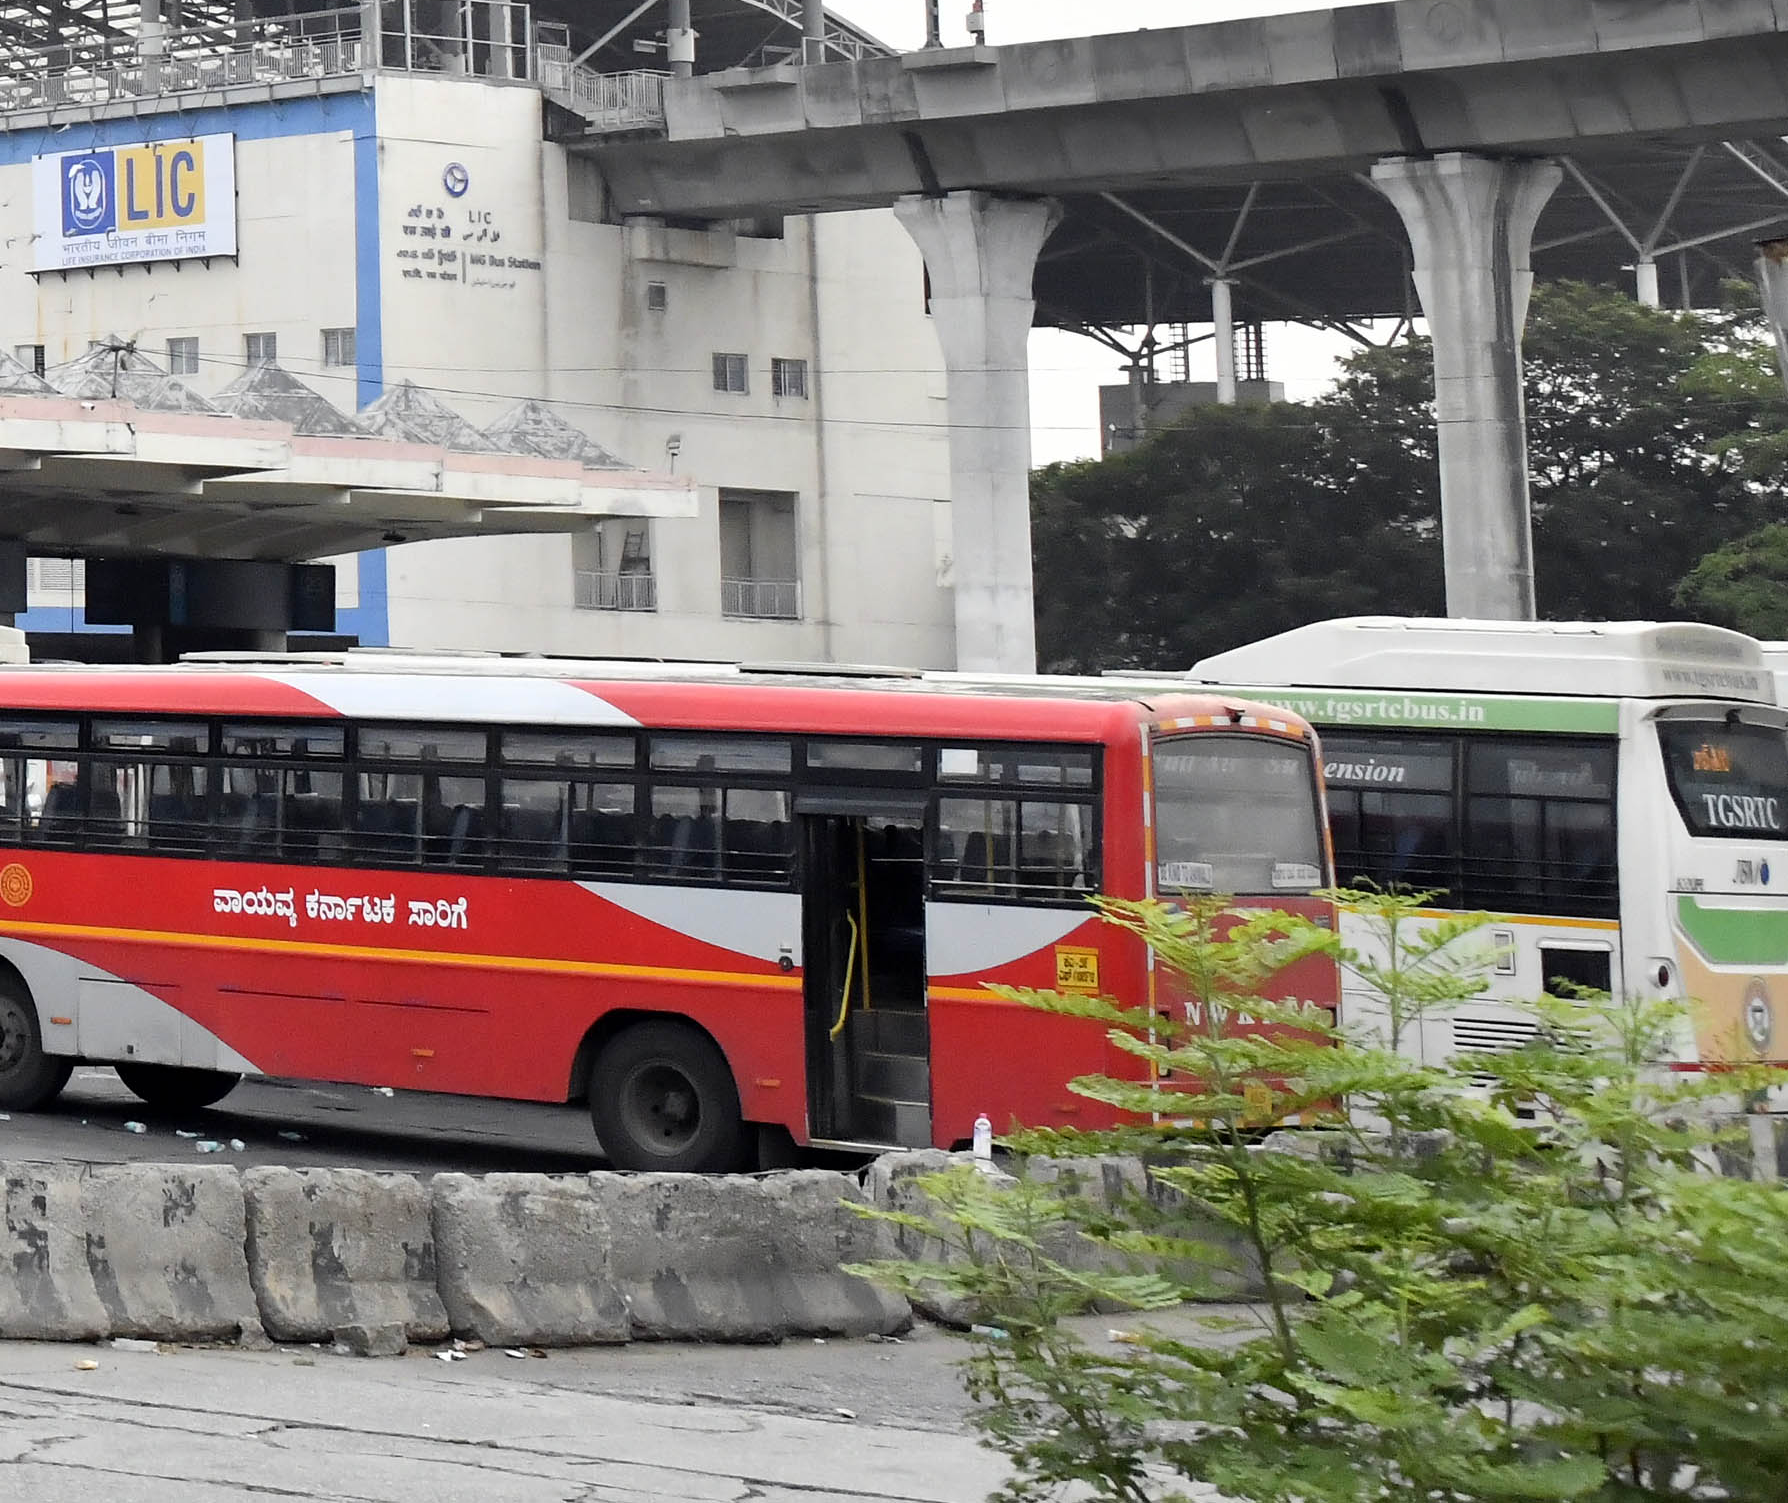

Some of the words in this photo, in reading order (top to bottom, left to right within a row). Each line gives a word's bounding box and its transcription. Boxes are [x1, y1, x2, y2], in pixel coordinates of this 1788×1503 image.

[126, 150, 196, 221] LIC
[468, 209, 492, 225] LIC
[507, 256, 541, 271] Station
[1262, 697, 1485, 723] ww.tgsrtcbus.in
[1324, 758, 1405, 783] ension
[1702, 793, 1780, 829] TGSRTC
[213, 886, 298, 928] ವಾಯವ್ಯ
[305, 889, 396, 924] ಕರ್ನಾಟಕ
[408, 896, 468, 929] ಸಾರಿಗೆ
